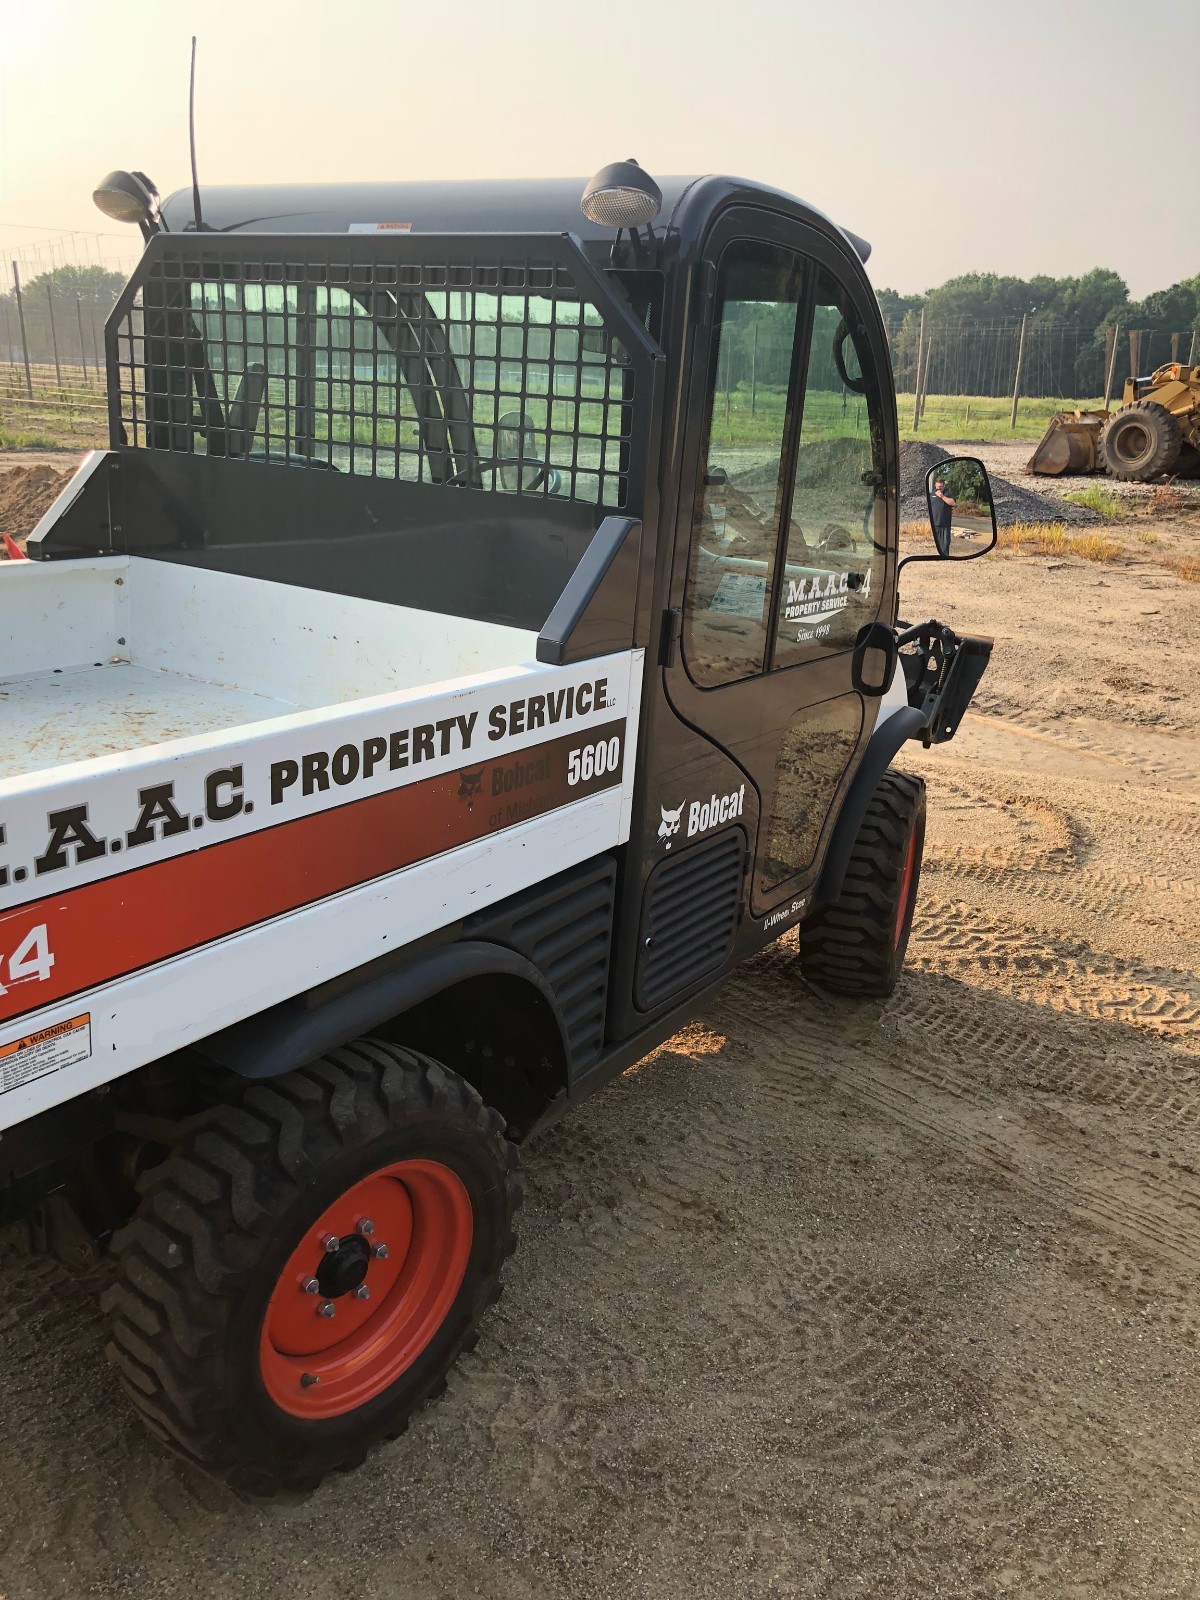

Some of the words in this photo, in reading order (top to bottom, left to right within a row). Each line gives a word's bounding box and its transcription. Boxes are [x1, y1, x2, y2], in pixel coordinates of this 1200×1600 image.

[785, 600, 821, 619] PROPERTY
[821, 595, 848, 611] SERVICE
[796, 628, 814, 642] Since
[815, 623, 831, 639] 1998
[0, 763, 255, 888] .A.A.C.
[270, 711, 479, 806] PROPERTY
[487, 677, 608, 742] SERVICE
[606, 697, 617, 708] LLC
[491, 751, 550, 797] Bobcat
[567, 736, 620, 786] 5600
[489, 806, 503, 827] of
[687, 783, 745, 838] Bobcat
[0, 923, 55, 996] 4
[30, 1021, 73, 1044] WARNING
